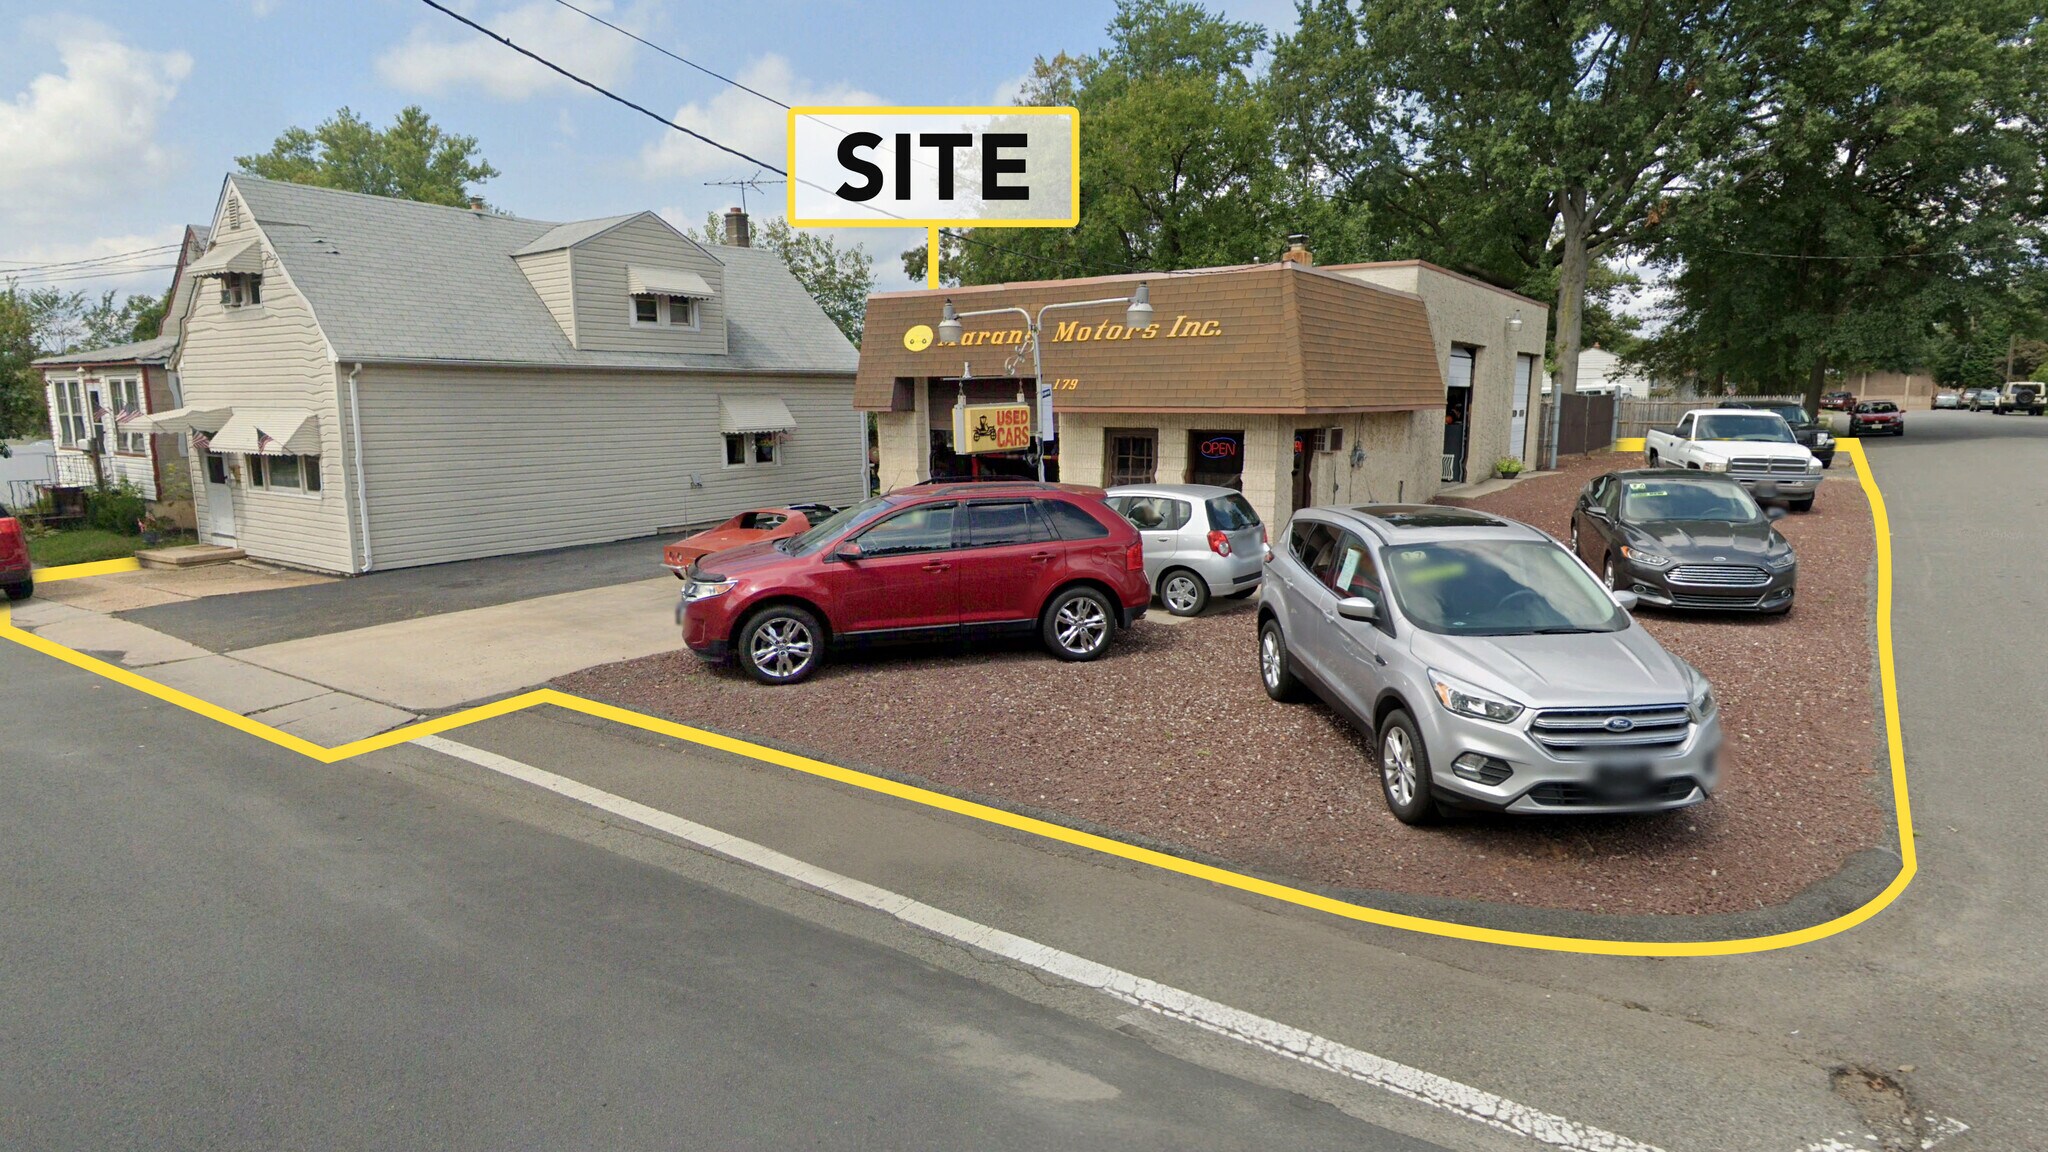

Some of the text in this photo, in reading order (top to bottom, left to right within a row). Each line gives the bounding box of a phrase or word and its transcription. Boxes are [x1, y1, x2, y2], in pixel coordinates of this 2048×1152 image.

[937, 315, 1223, 347] aran Motors Inc.
[1053, 378, 1079, 390] 179
[996, 409, 1028, 427] USED
[996, 426, 1029, 448] CARS
[1201, 441, 1236, 456] OPEN
